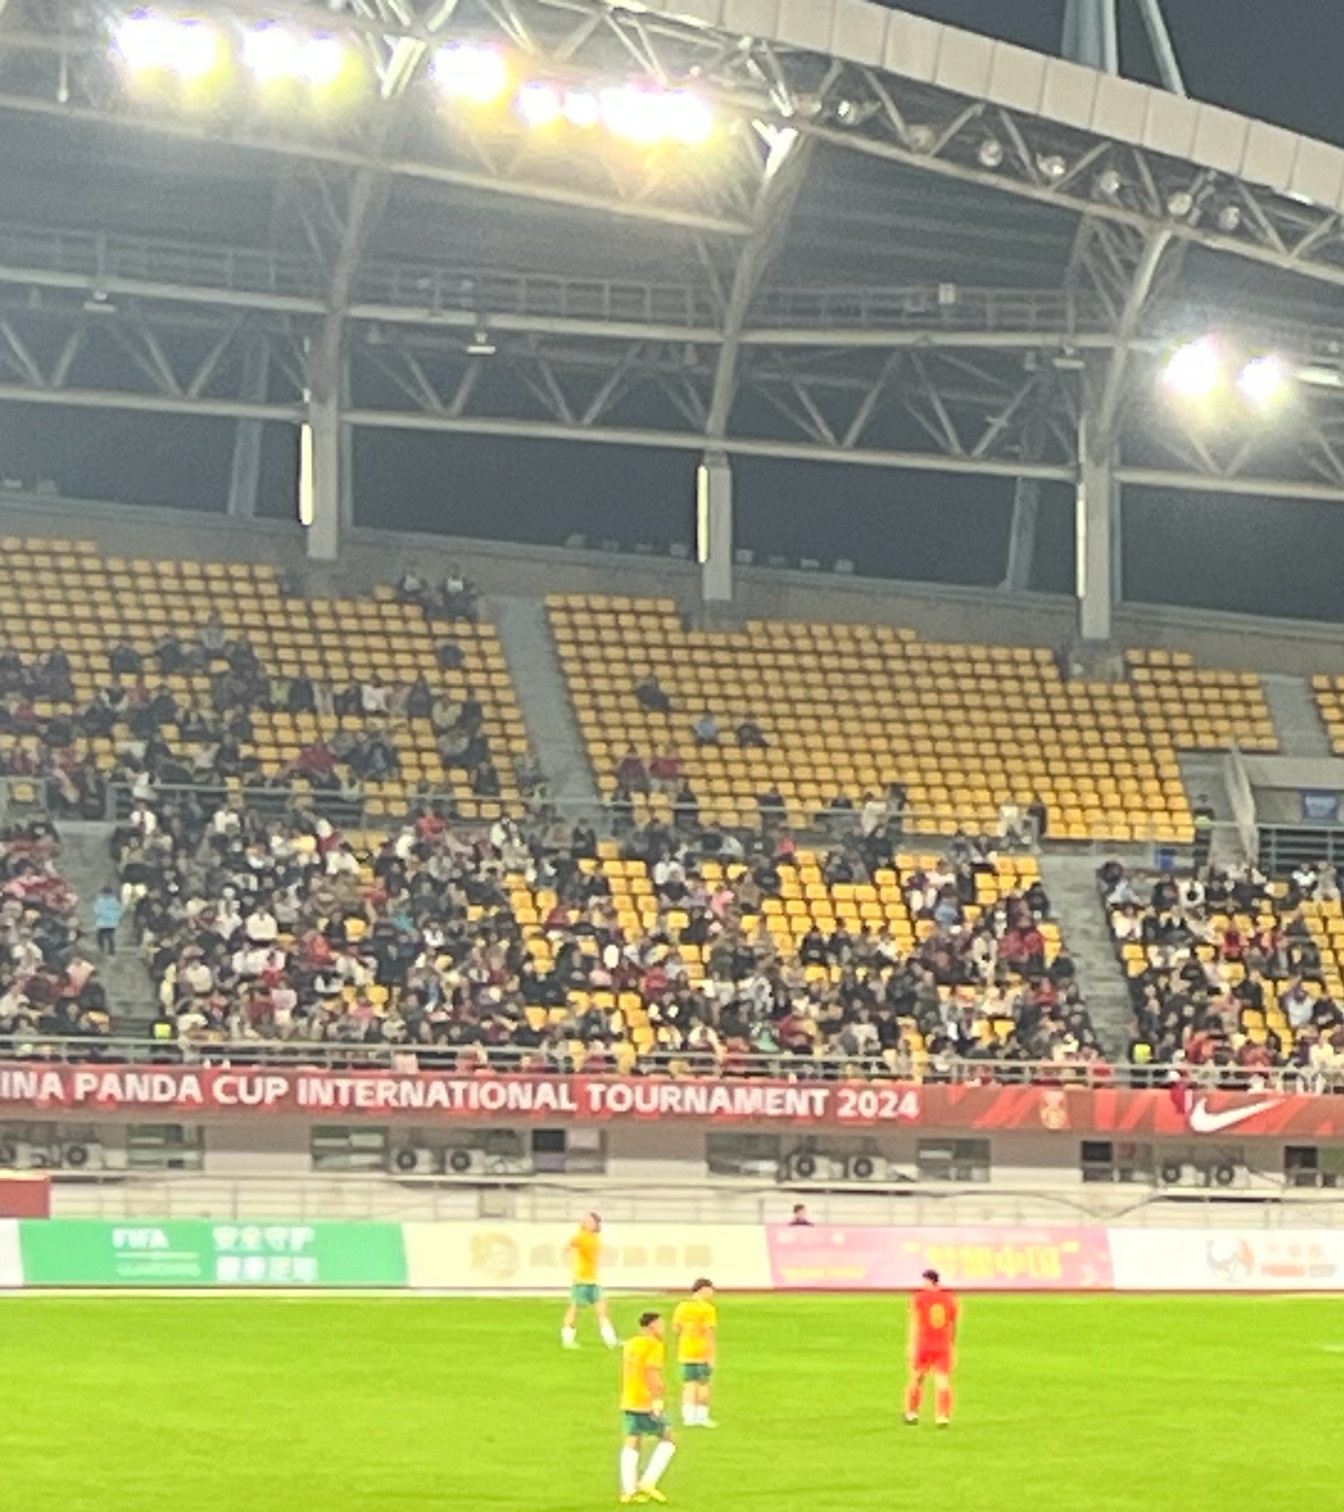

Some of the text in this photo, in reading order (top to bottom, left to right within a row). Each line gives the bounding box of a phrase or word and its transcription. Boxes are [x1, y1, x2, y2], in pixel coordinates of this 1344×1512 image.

[75, 1072, 201, 1102] PANDA
[212, 1075, 290, 1105] CUP
[300, 1078, 578, 1111] INTERNATIONAL
[587, 1082, 830, 1117] TOURNAMENT
[836, 1088, 921, 1120] 2024
